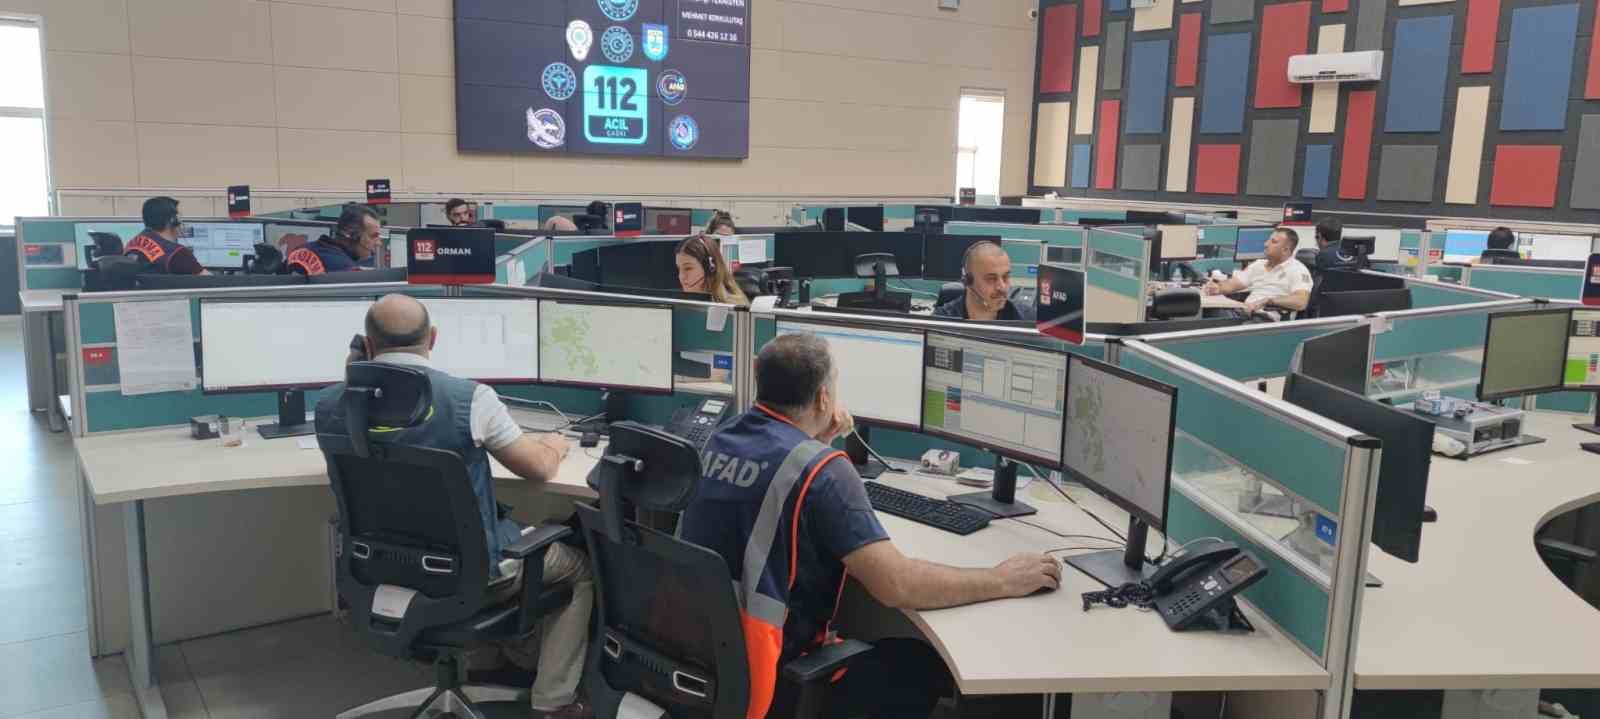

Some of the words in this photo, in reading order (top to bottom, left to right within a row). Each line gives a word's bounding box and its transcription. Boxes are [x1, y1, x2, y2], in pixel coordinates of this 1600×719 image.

[594, 76, 637, 111] 112
[416, 242, 433, 252] 112
[436, 247, 472, 255] ORMAN
